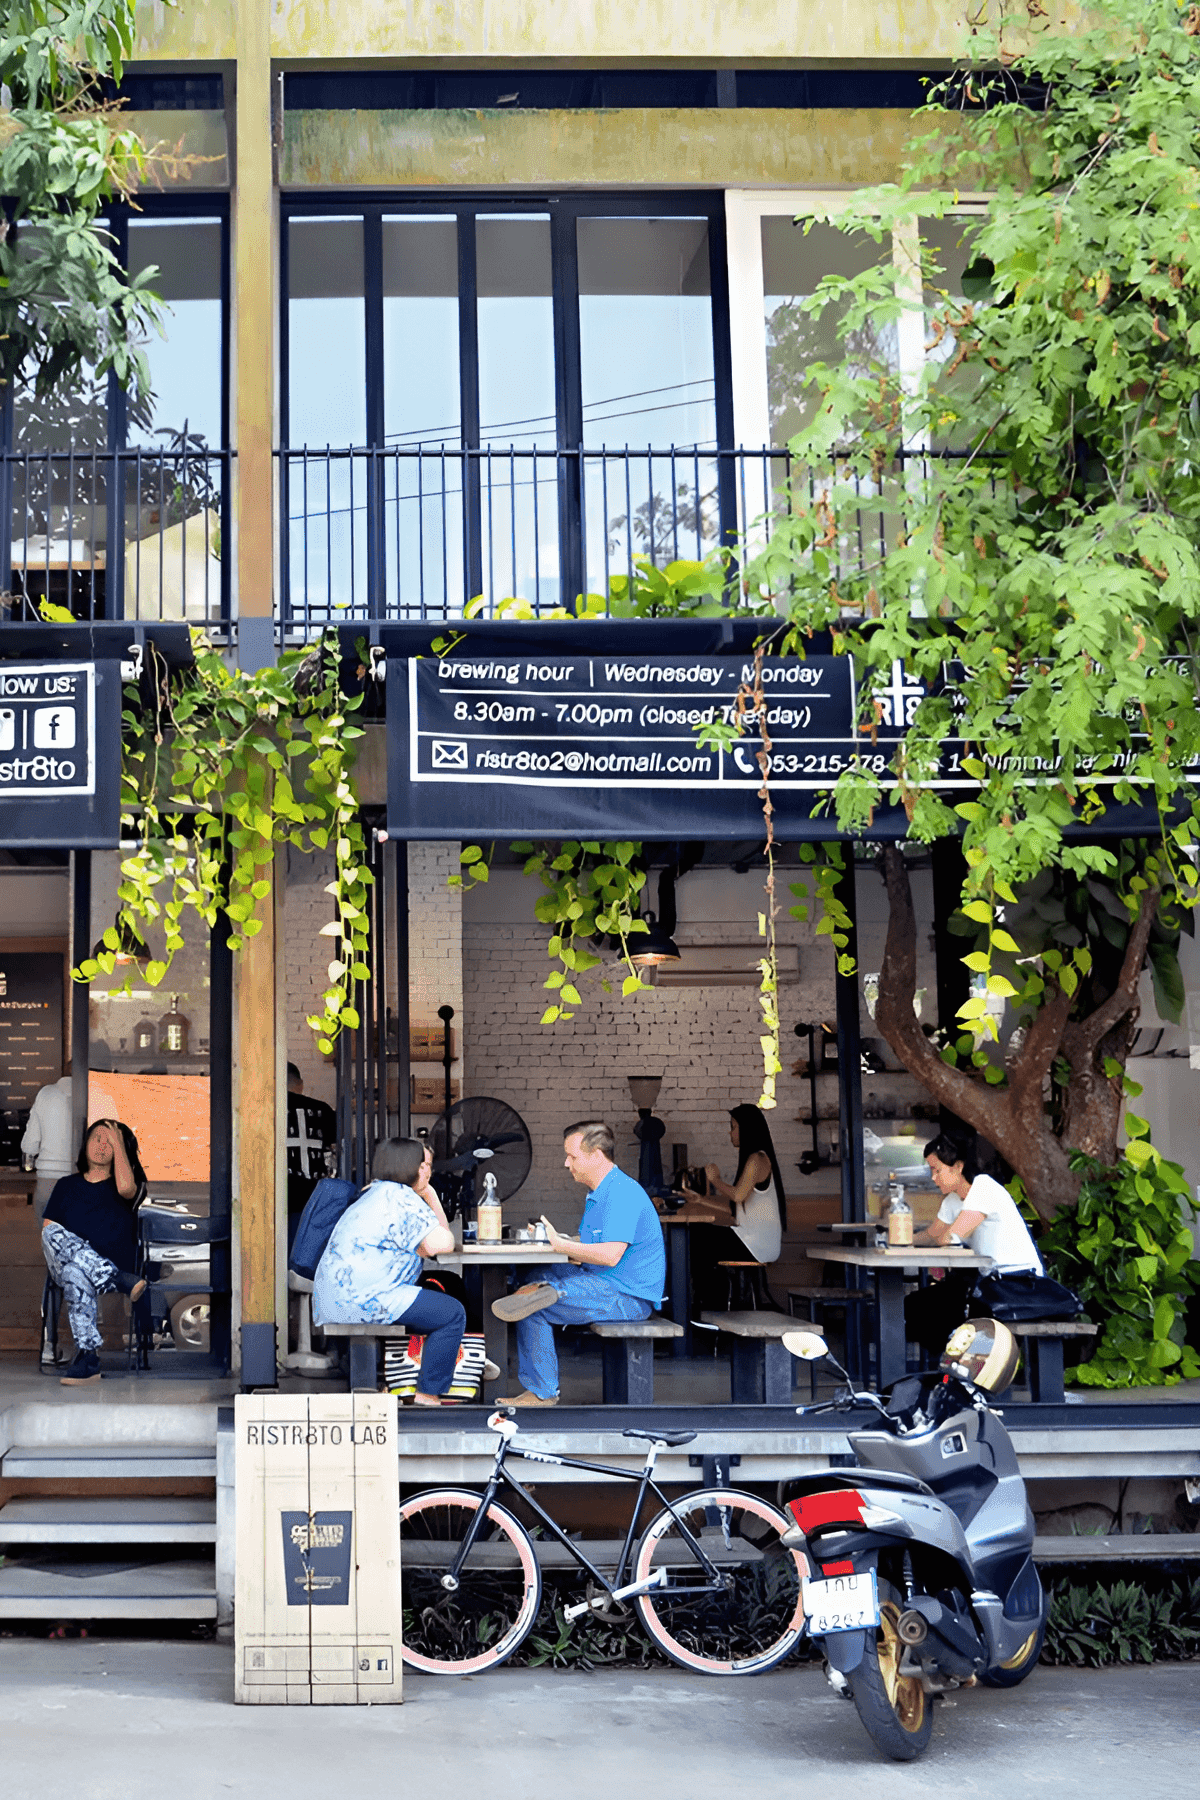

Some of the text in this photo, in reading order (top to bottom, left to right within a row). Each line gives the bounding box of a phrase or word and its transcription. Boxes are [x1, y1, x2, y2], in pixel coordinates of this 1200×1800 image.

[438, 661, 574, 684] brewing hour
[604, 664, 724, 686] Wednesday
[741, 664, 823, 687] Monday
[44, 676, 78, 694] us:
[453, 701, 535, 722] 8.30am
[555, 703, 634, 727] 7.00pm
[639, 704, 714, 727] (closed
[721, 705, 811, 729] Teday)
[476, 750, 711, 773] ristr8to2@hotmail.com
[247, 1425, 387, 1446] RISTR8TO LAB
